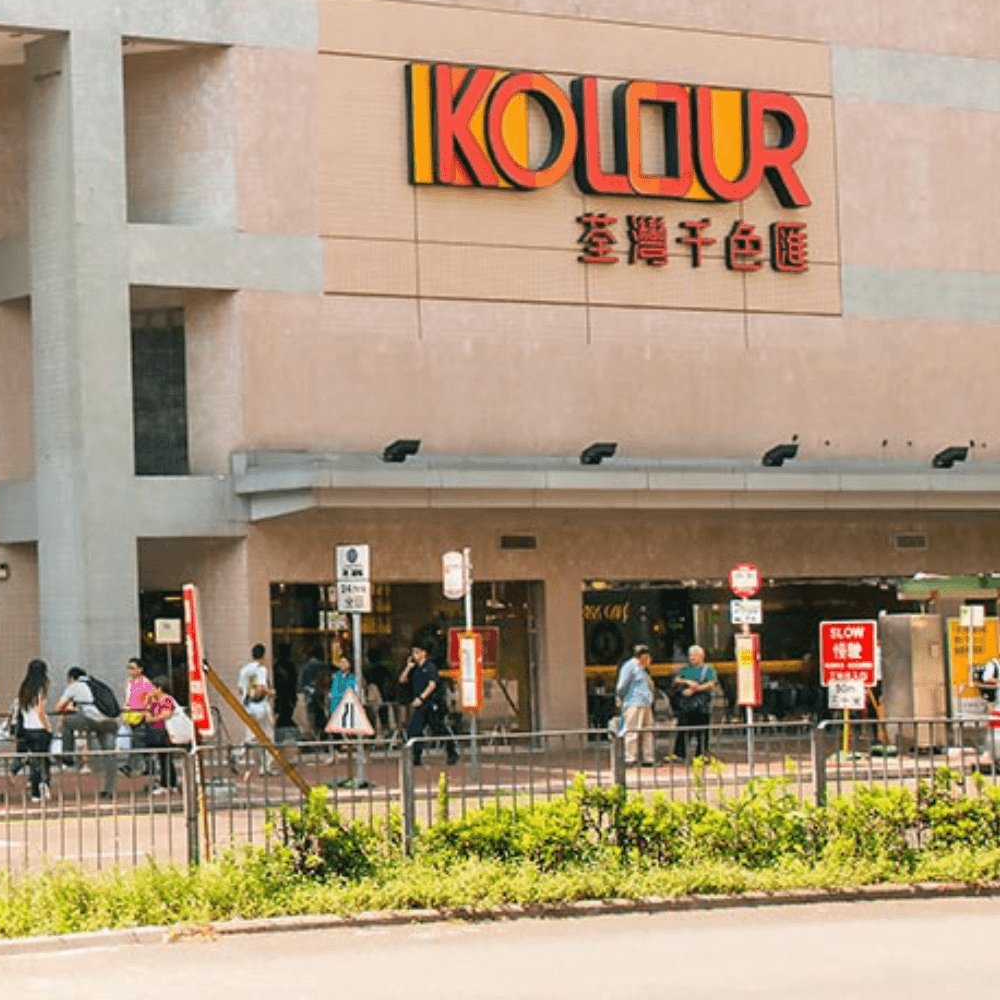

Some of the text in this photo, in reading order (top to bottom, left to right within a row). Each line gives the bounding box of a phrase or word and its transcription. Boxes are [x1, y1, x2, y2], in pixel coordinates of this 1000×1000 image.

[405, 62, 812, 208] KOLOUR
[576, 213, 808, 273] 荃灣千色匯
[830, 626, 865, 640] SLOW
